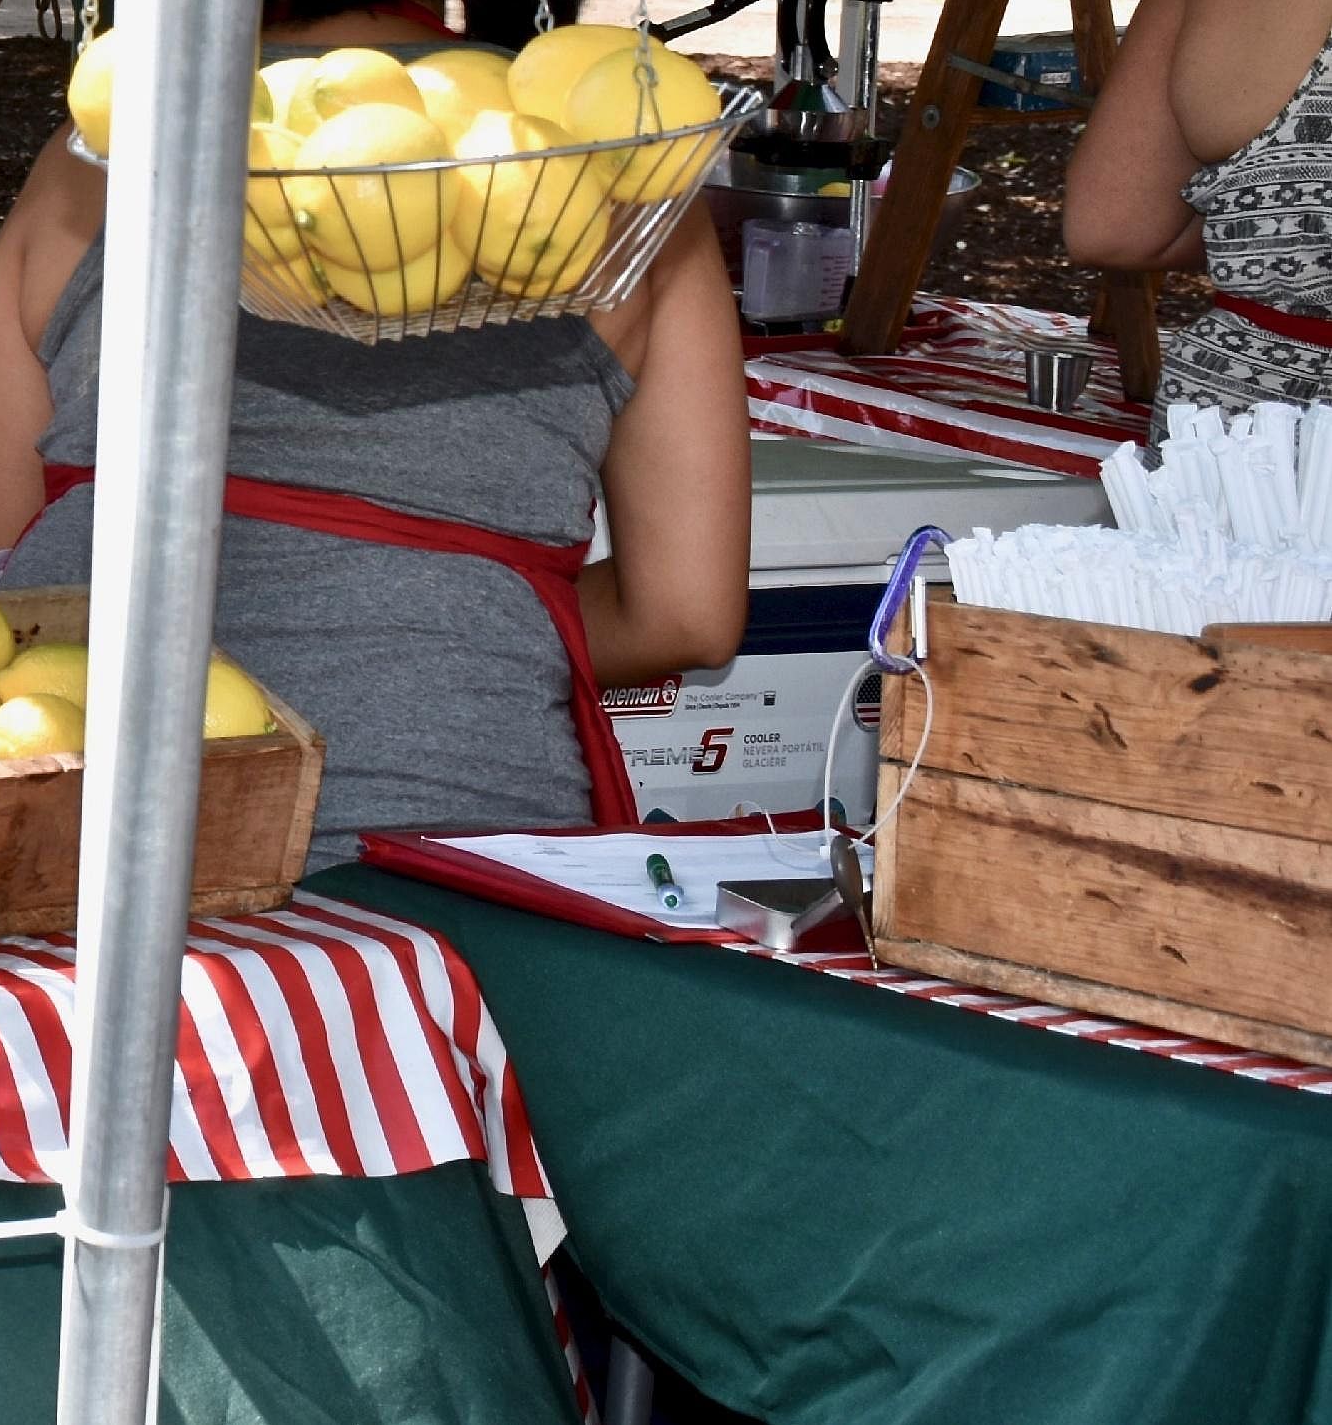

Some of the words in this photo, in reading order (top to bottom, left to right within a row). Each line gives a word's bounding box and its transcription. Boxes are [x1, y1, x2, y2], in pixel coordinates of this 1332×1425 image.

[599, 687, 660, 706] oleman
[743, 733, 781, 744] COOLER
[743, 745, 779, 757] NEVERA
